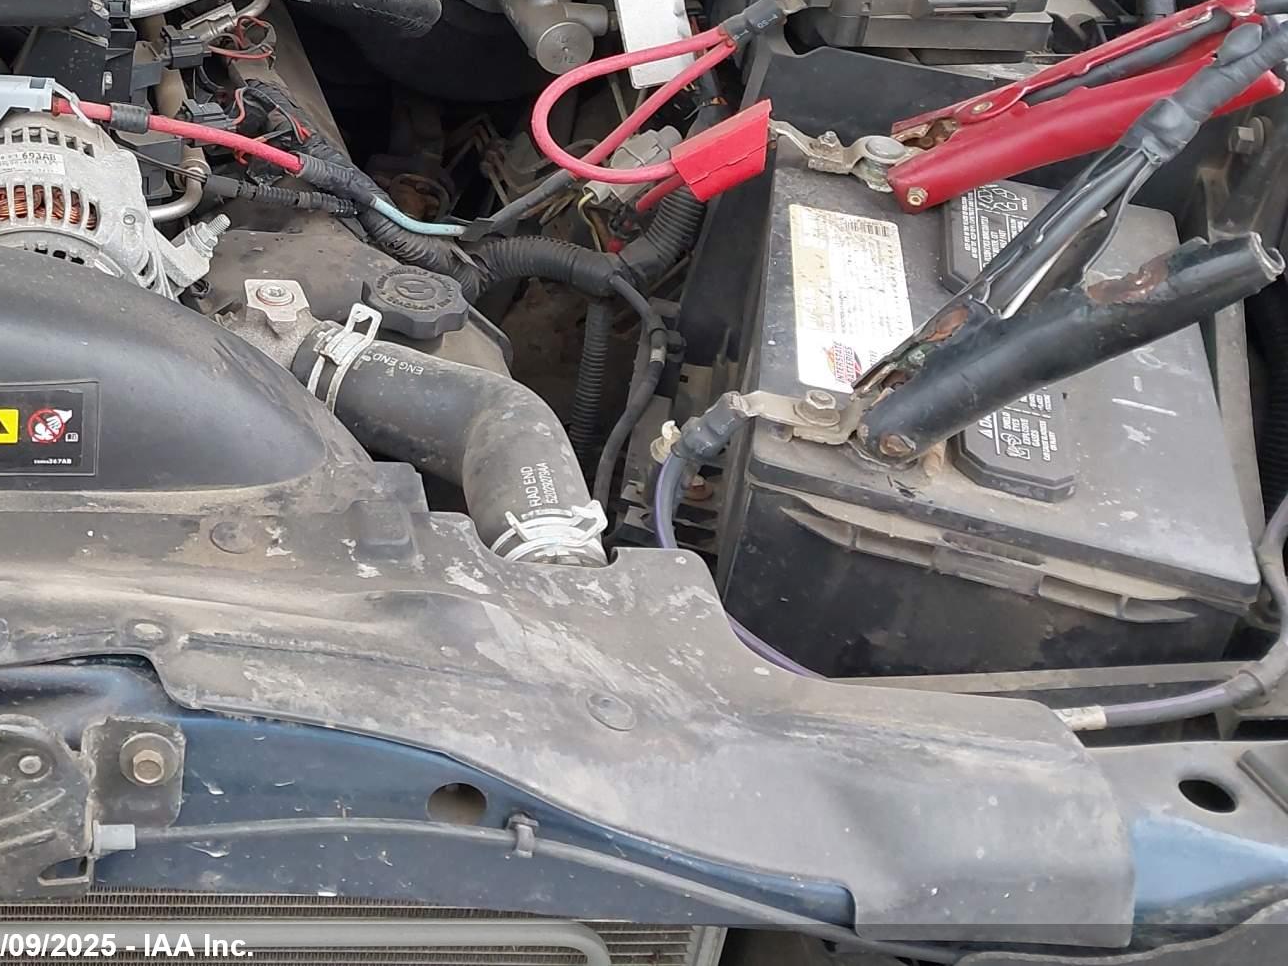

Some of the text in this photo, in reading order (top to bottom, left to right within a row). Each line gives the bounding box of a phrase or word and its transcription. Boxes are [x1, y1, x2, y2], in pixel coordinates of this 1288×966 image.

[372, 353, 424, 375] ENG END
[833, 341, 847, 384] INTERSTATE
[844, 346, 855, 383] BATTERIES
[1001, 411, 1012, 430] SHIELD
[1011, 418, 1021, 432] EYES
[1020, 417, 1032, 445] EXPLOSIVE
[1030, 429, 1041, 447] GASES
[520, 466, 543, 507] RAD END
